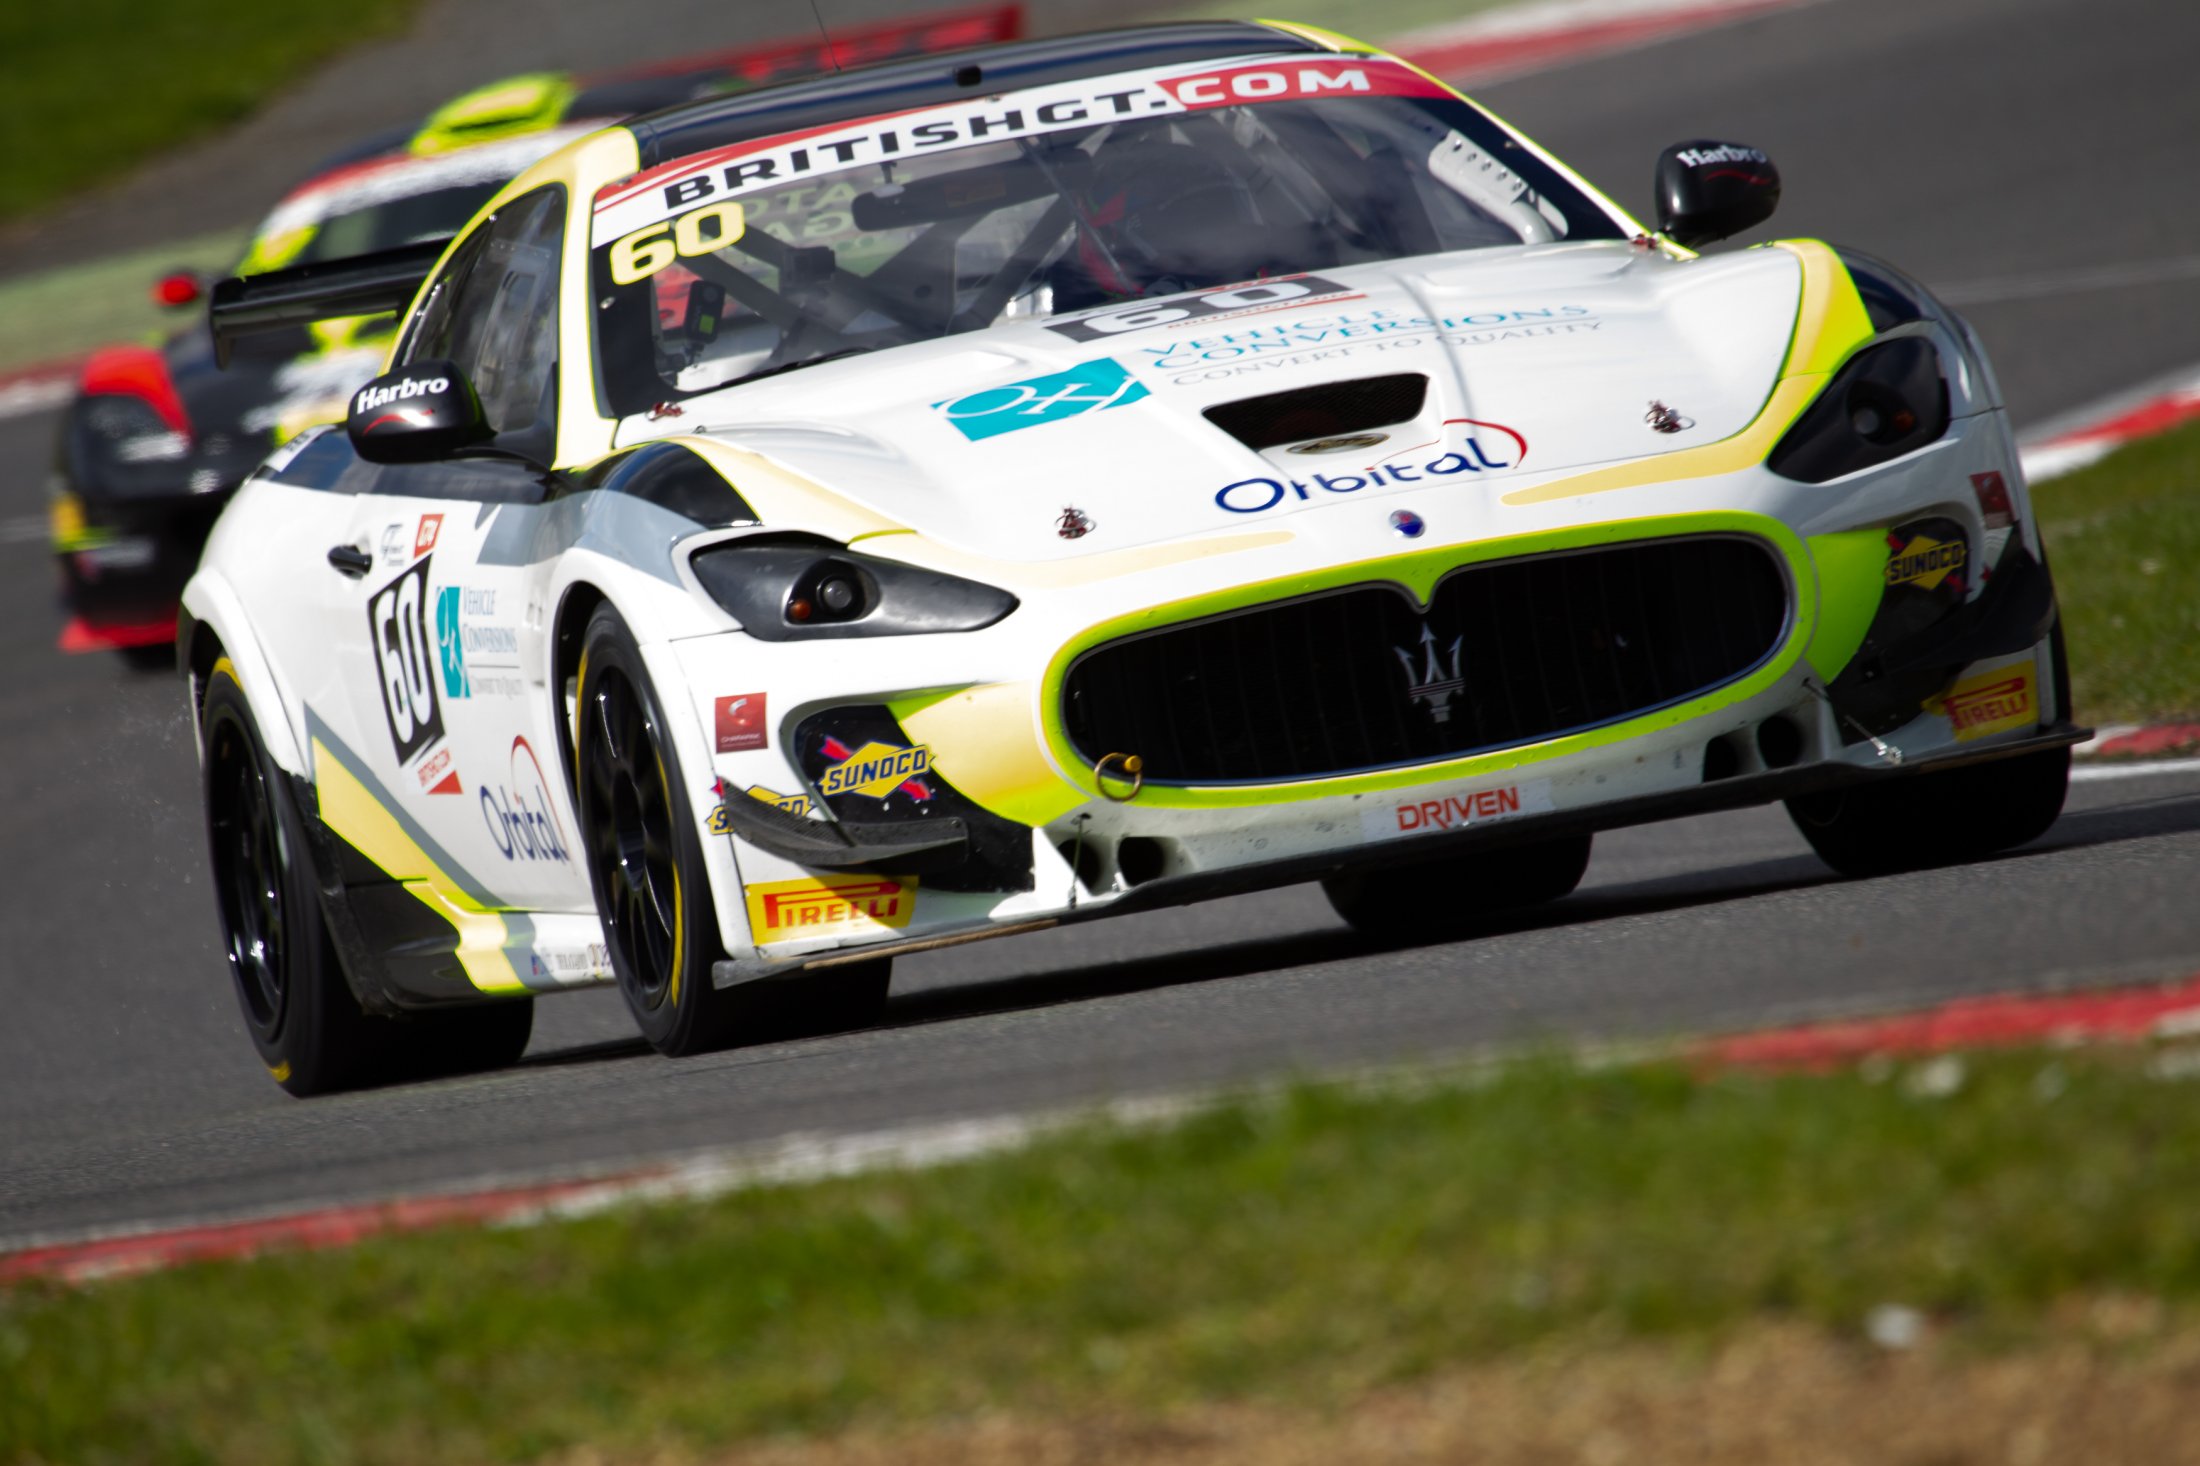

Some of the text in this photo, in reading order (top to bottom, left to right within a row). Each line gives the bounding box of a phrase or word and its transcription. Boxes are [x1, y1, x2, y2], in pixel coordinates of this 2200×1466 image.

[664, 69, 1371, 209] BRITISHGT.COM
[1676, 144, 1767, 168] Harbro
[610, 201, 745, 285] 60
[1083, 281, 1311, 334] 60
[1142, 308, 1401, 356] VEHICLE
[1153, 304, 1590, 369] CONVERSIONS
[1173, 321, 1602, 385] CONVERT TO QUALITY
[357, 377, 449, 414] Harbro
[1215, 437, 1509, 513] Orbital
[1889, 544, 1963, 581] SUNOCO
[375, 571, 432, 744] 60
[1946, 676, 2029, 731] PIRELLI
[828, 748, 927, 792] SUNOCO
[480, 785, 570, 865] Orbital
[1397, 787, 1520, 830] DRIVEN
[763, 881, 902, 928] PIRELLI
